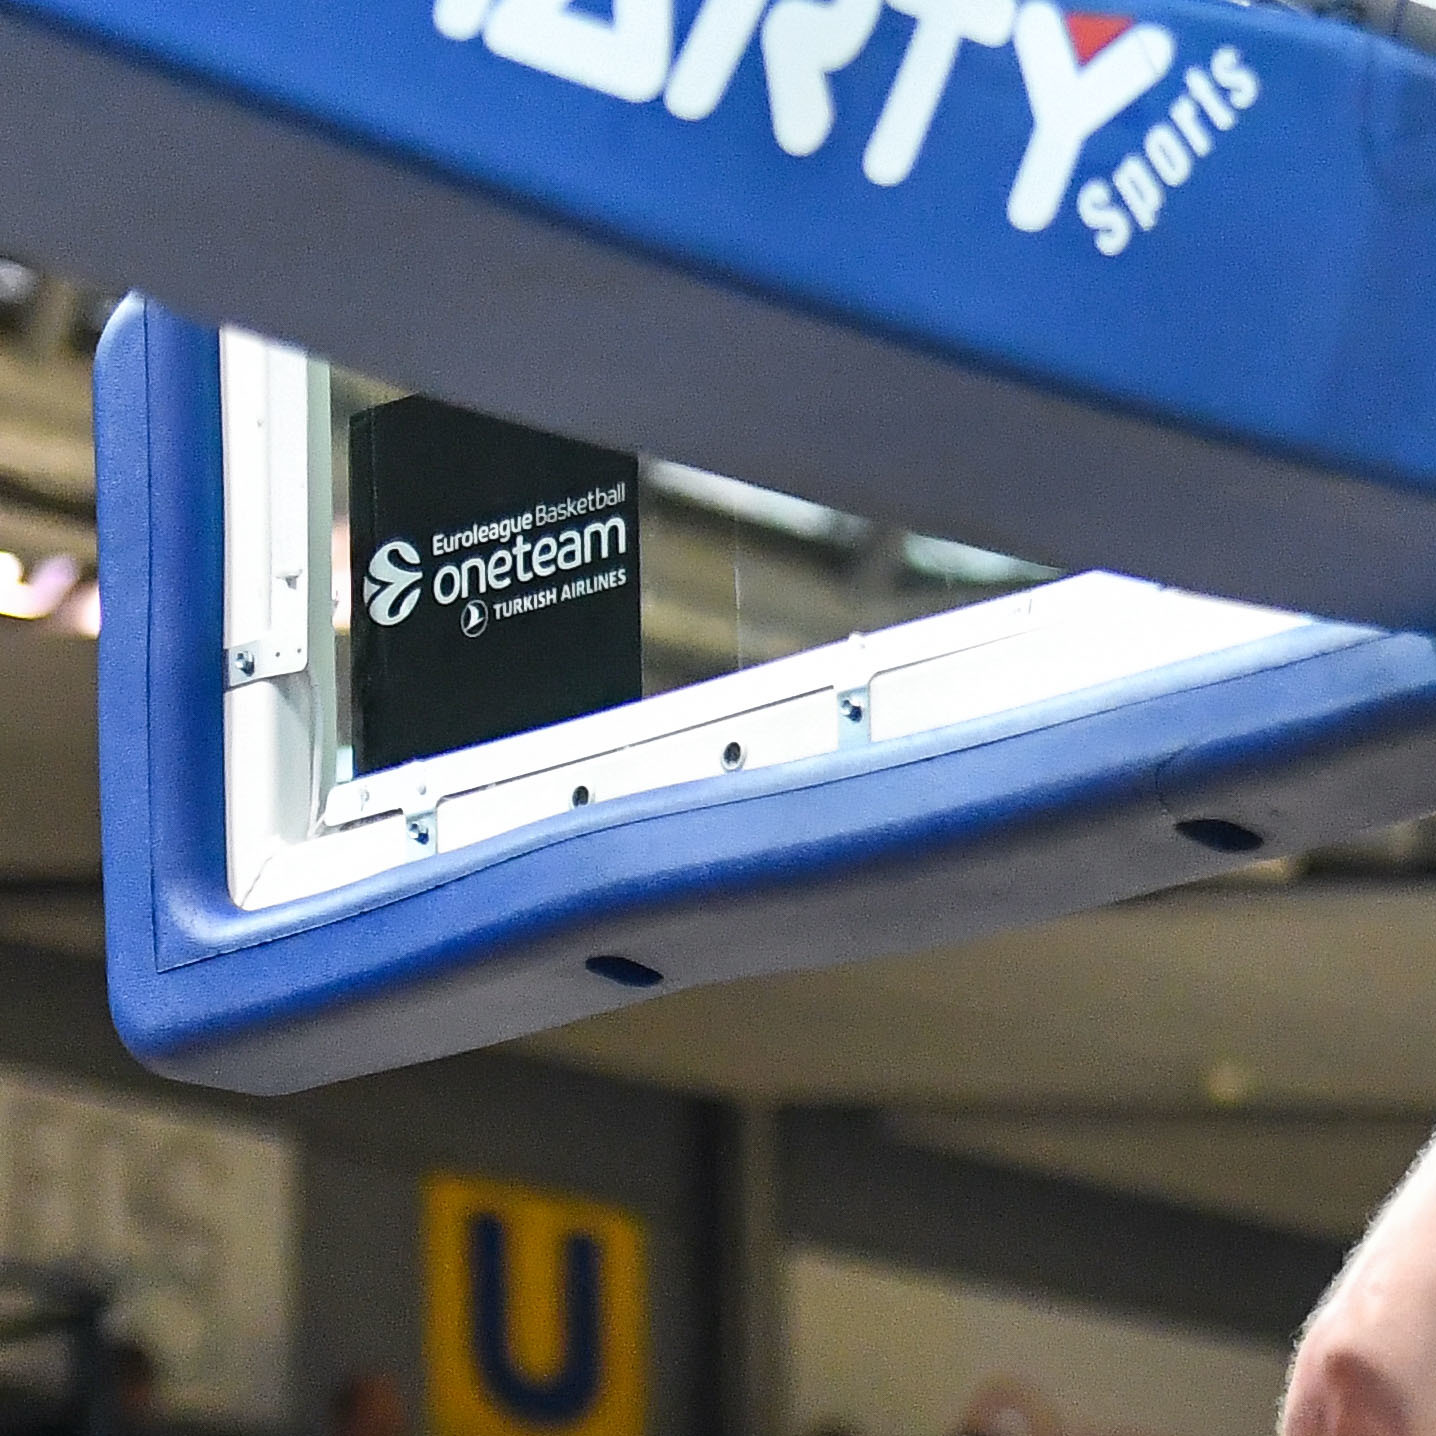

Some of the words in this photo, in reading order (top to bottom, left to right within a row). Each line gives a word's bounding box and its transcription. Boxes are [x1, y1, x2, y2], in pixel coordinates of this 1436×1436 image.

[1076, 46, 1260, 256] Sports
[432, 513, 532, 555] Euroleague
[535, 482, 626, 527] Basketball
[433, 516, 627, 605] oneteam
[493, 589, 557, 620] TURKISH
[560, 568, 627, 601] AIRLINES
[468, 1212, 600, 1430] U
